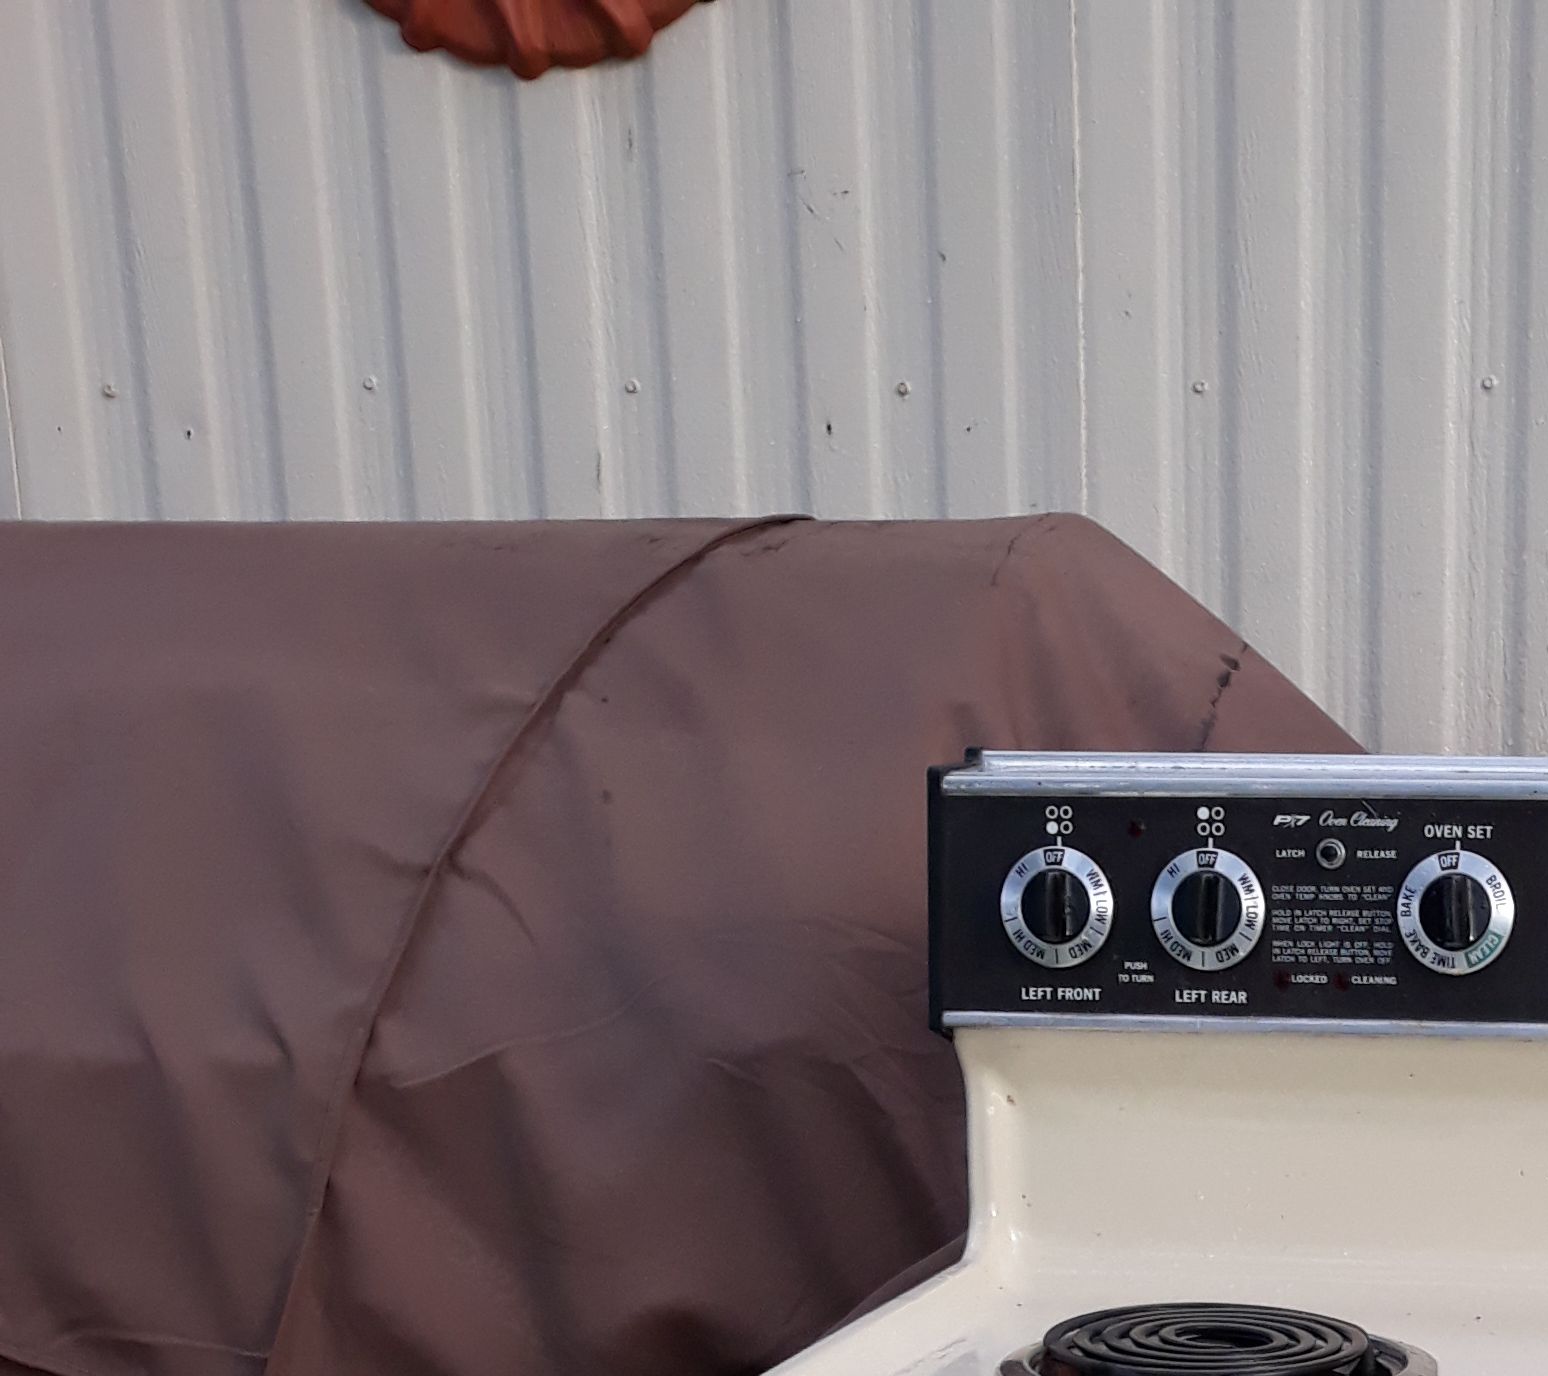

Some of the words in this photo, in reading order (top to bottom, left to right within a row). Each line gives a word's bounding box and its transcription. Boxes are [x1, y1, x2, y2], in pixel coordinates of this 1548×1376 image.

[1318, 810, 1348, 827] Oven
[1424, 824, 1463, 838] OVEN
[1467, 825, 1493, 839] SET
[1045, 851, 1064, 863] OFF
[1198, 853, 1217, 866] OFF
[1275, 849, 1306, 858] LATCH
[1356, 849, 1398, 859] RELEASE
[1440, 855, 1458, 868] OFF
[1015, 863, 1028, 878] HI
[1166, 862, 1180, 878] HI
[1086, 868, 1104, 891] WM
[1237, 873, 1255, 896] WM
[1400, 885, 1417, 917] BAKE
[1485, 874, 1507, 913] BROIL
[1094, 900, 1109, 925] LOW
[1244, 903, 1259, 931] LOW
[1012, 929, 1025, 943] HI
[1160, 929, 1172, 944] HI
[1404, 928, 1429, 959] BAKE
[1023, 940, 1046, 960] MED
[1070, 939, 1093, 959] MED
[1170, 940, 1192, 963] MED
[1216, 943, 1240, 963] MED
[1124, 961, 1148, 971] PUSH
[1430, 951, 1455, 969] TIME
[1118, 973, 1129, 983] TO
[1131, 973, 1154, 983] TURN
[1291, 974, 1328, 984] LOCKED
[1351, 975, 1398, 985] CLEANING
[1021, 987, 1053, 1000] LEFT
[1057, 987, 1102, 1001] FRONT
[1175, 989, 1208, 1003] LEFT
[1211, 990, 1248, 1004] REAR
